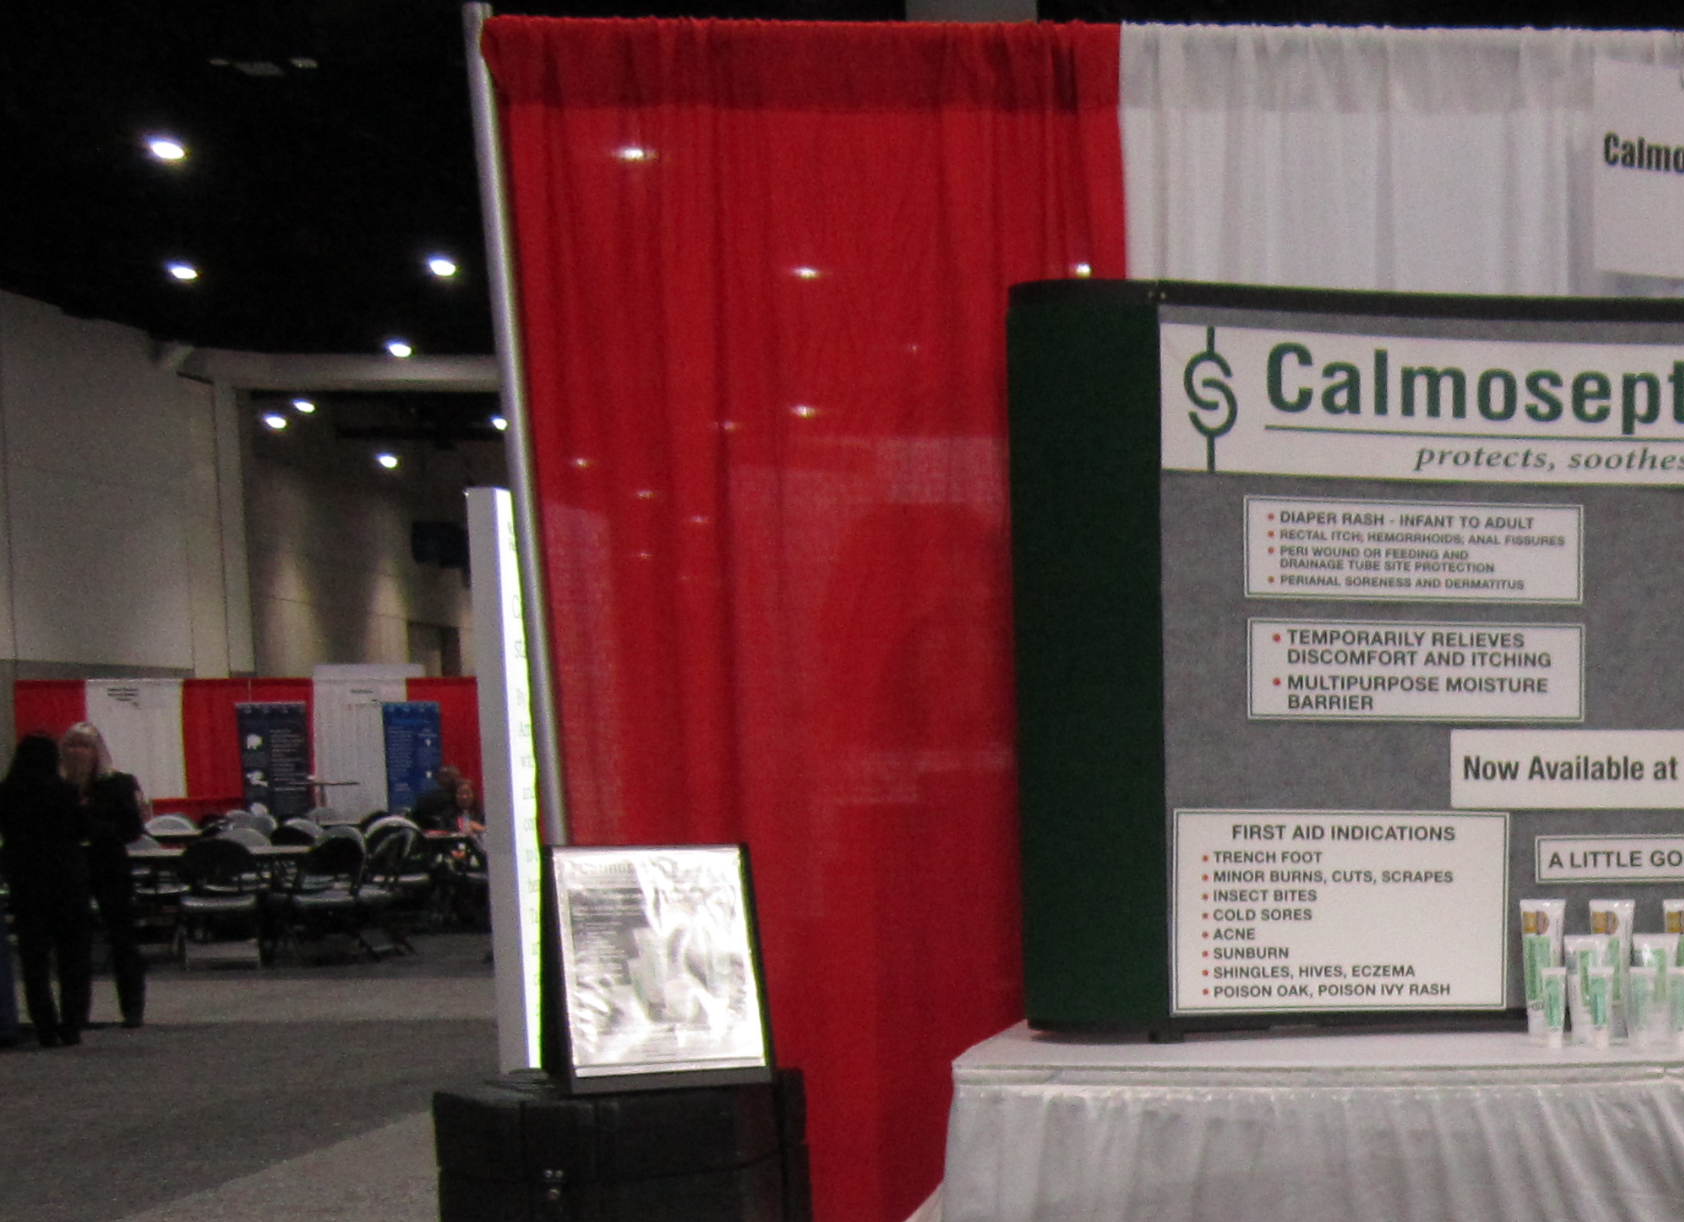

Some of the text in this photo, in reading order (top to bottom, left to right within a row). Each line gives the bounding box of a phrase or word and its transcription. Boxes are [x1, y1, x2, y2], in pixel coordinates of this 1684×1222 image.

[1413, 446, 1557, 472] protects,
[1279, 509, 1337, 525] DIAPER
[1341, 511, 1385, 527] RASH
[1398, 513, 1454, 528] INFANT
[1458, 515, 1480, 529] TO
[1483, 515, 1534, 530] ADULT
[1279, 527, 1328, 541] RECTAL
[1467, 533, 1501, 546] ANAL
[1503, 534, 1565, 547] FISSURES
[1279, 544, 1469, 562] PERI WOUND OR FEEDING AND
[1279, 557, 1495, 574] DRAINAGE TUBE SITE PROTECTION
[1279, 573, 1525, 591] PERIANAL SORENESS AND DERMATITUS
[1286, 628, 1525, 650] TEMPORARILY RELIEVES
[1286, 647, 1552, 668] DISCOMFORT AND ITCHING
[1286, 673, 1548, 694] MULTIPURPOSE MOISTURE
[1287, 693, 1373, 711] BARRIER
[1462, 754, 1520, 781] Now
[1527, 754, 1645, 781] Available
[1652, 756, 1678, 781] at
[1231, 823, 1456, 842] FIRST AID INDICATIONS
[1212, 850, 1322, 864] TRENCH FOOT
[1547, 851, 1564, 869] A
[1569, 849, 1642, 869] LITTLE
[1212, 869, 1454, 885] MINOR BURNS, CUTS, SCRAPES
[1212, 888, 1318, 902] INSECT BITES
[1212, 907, 1313, 922] COLD SORES
[1212, 927, 1255, 941] ACNE
[1212, 946, 1289, 960] SUNBURN
[1212, 964, 1416, 980] SHINGLES, HIVES, ECZEMA
[1213, 982, 1451, 999] POISON OAK, POISON IVY RASH
